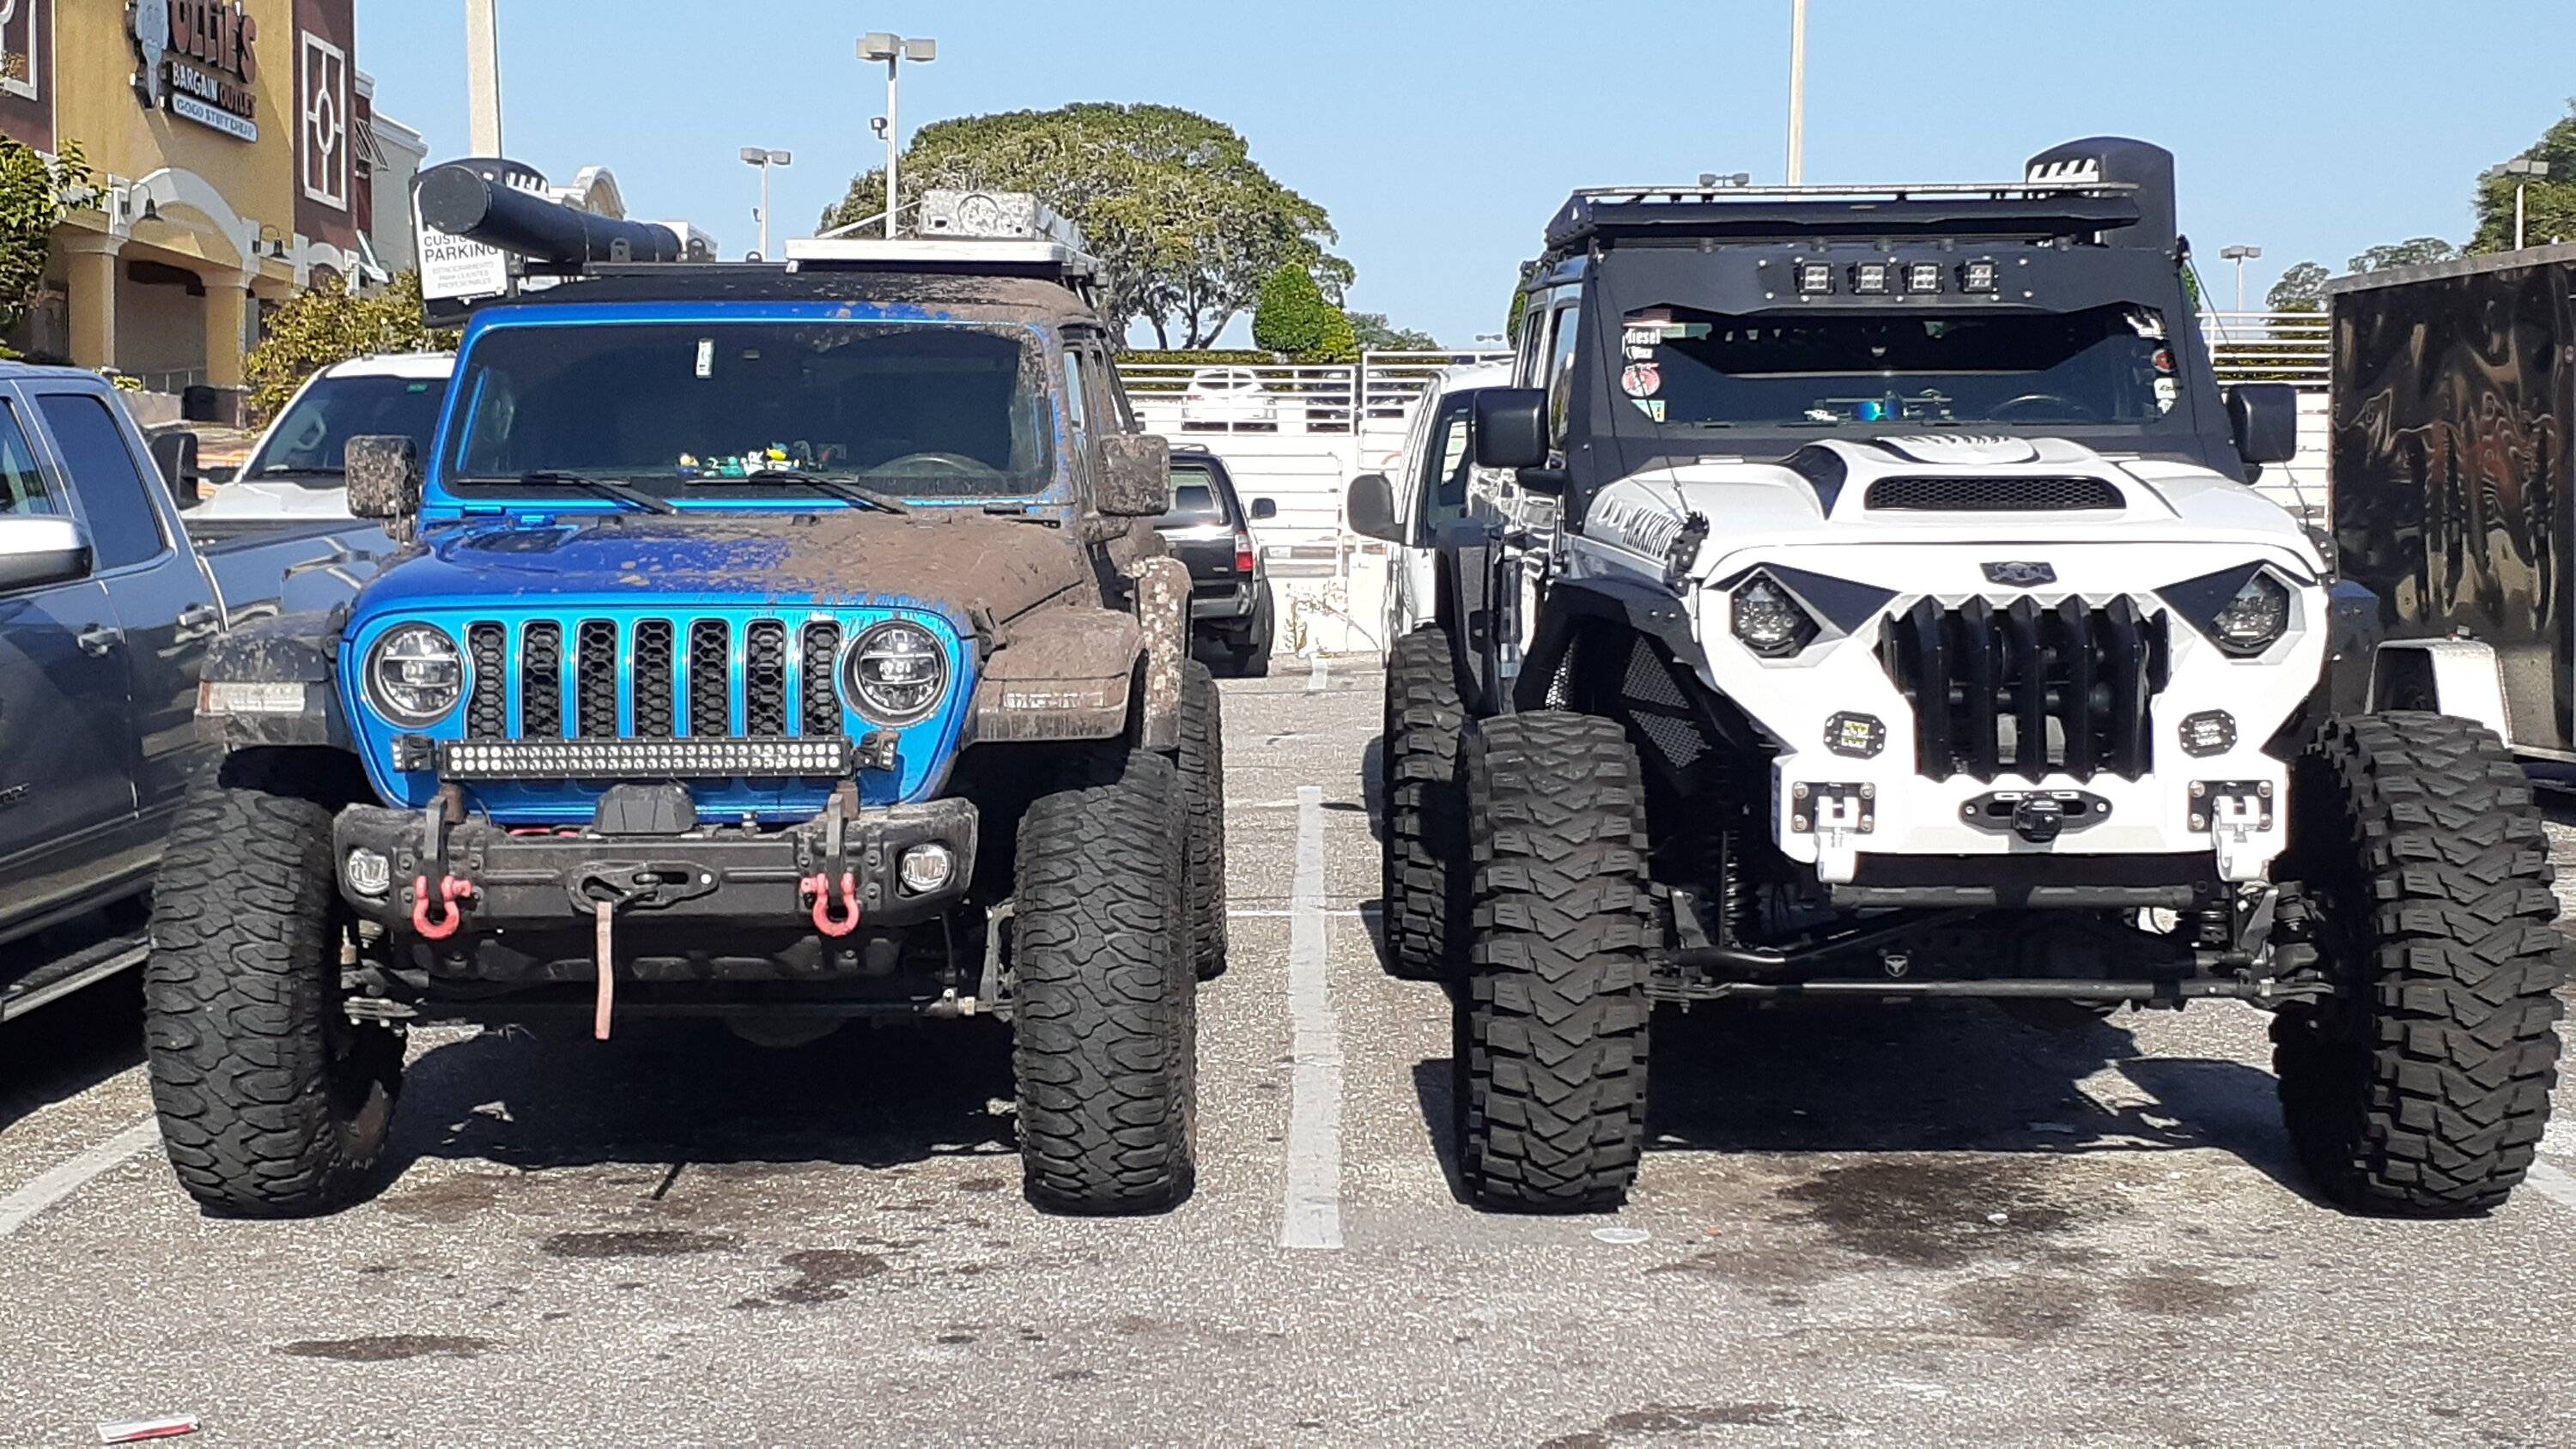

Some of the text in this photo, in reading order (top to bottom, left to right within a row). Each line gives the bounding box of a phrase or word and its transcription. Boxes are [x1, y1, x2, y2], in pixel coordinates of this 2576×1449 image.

[173, 61, 256, 118] BARGAIN OUTLET
[177, 98, 204, 118] GOOD
[205, 107, 230, 129] STUFF
[424, 243, 498, 263] PARKING
